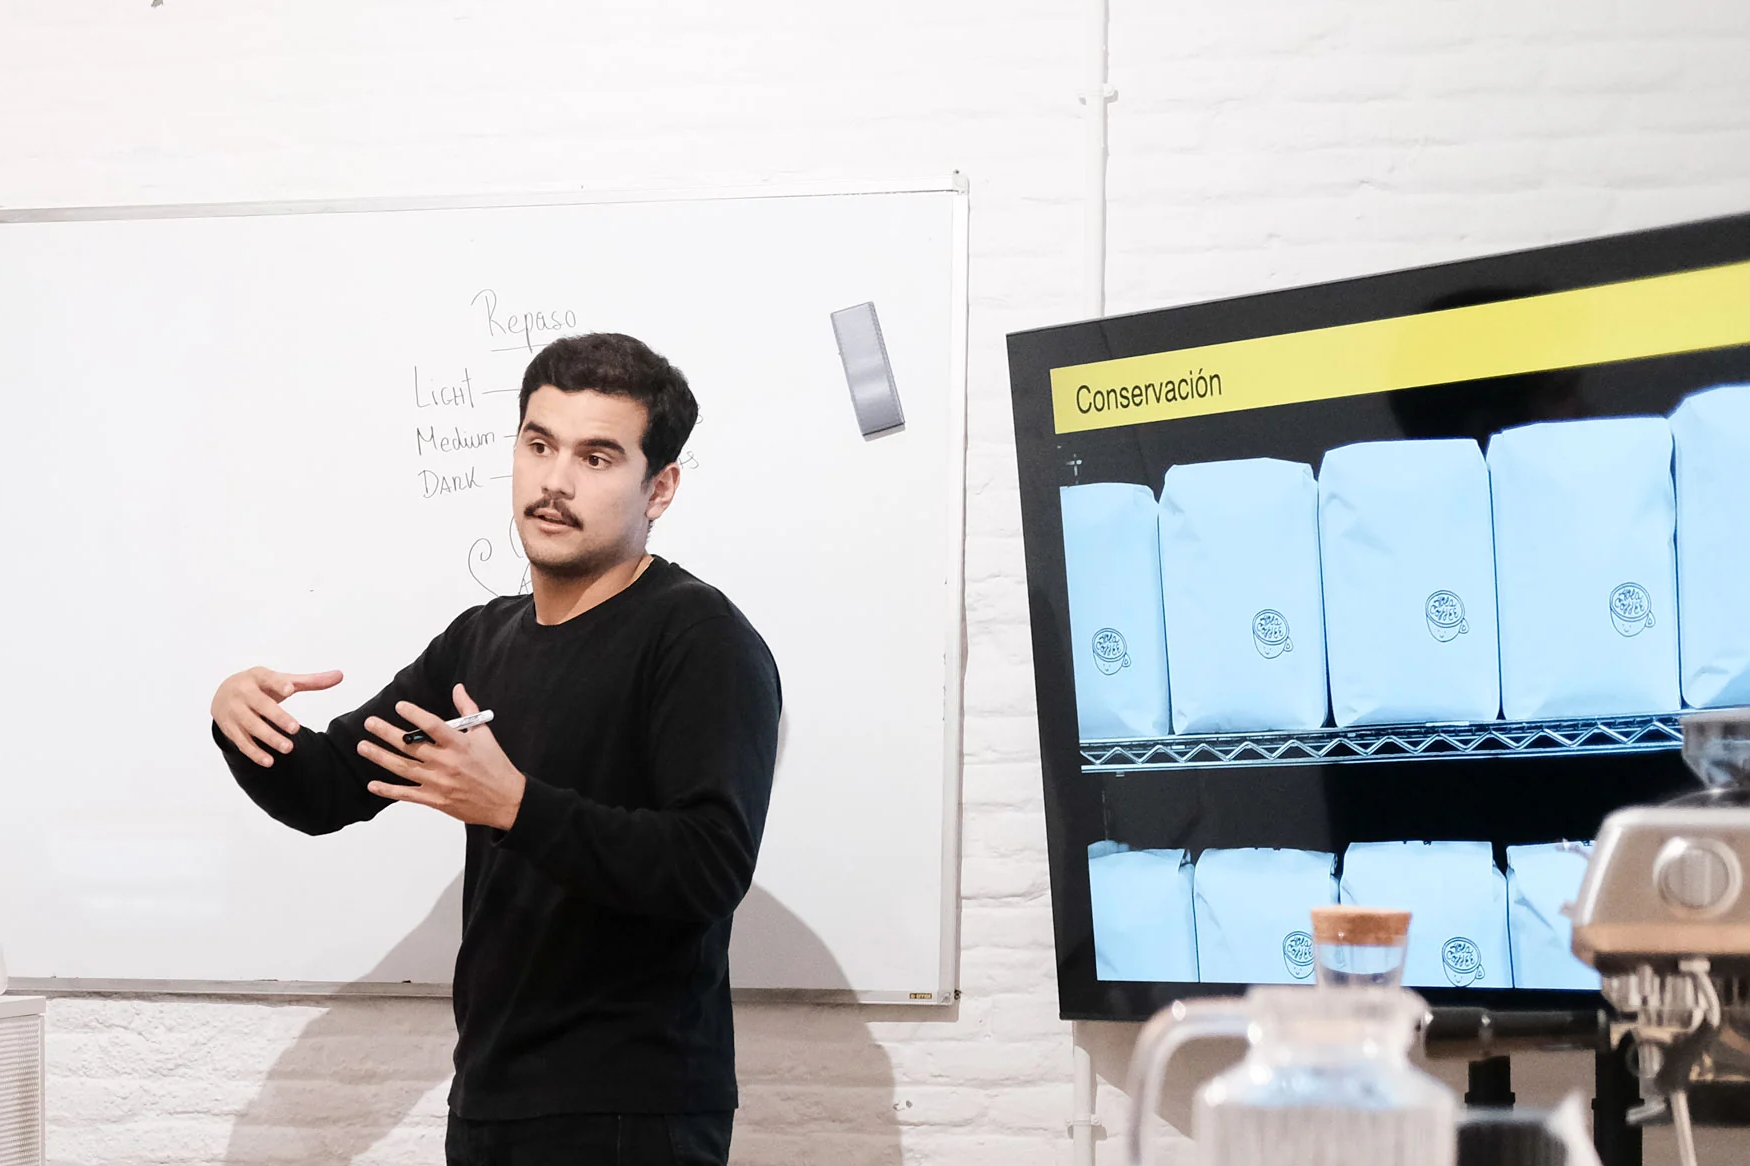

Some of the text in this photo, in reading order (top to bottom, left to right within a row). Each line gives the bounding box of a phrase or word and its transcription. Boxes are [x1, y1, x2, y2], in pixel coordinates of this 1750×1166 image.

[470, 288, 577, 354] Repaso
[1075, 367, 1223, 415] Conservación
[415, 425, 496, 456] Medium
[417, 465, 483, 499] DARK
